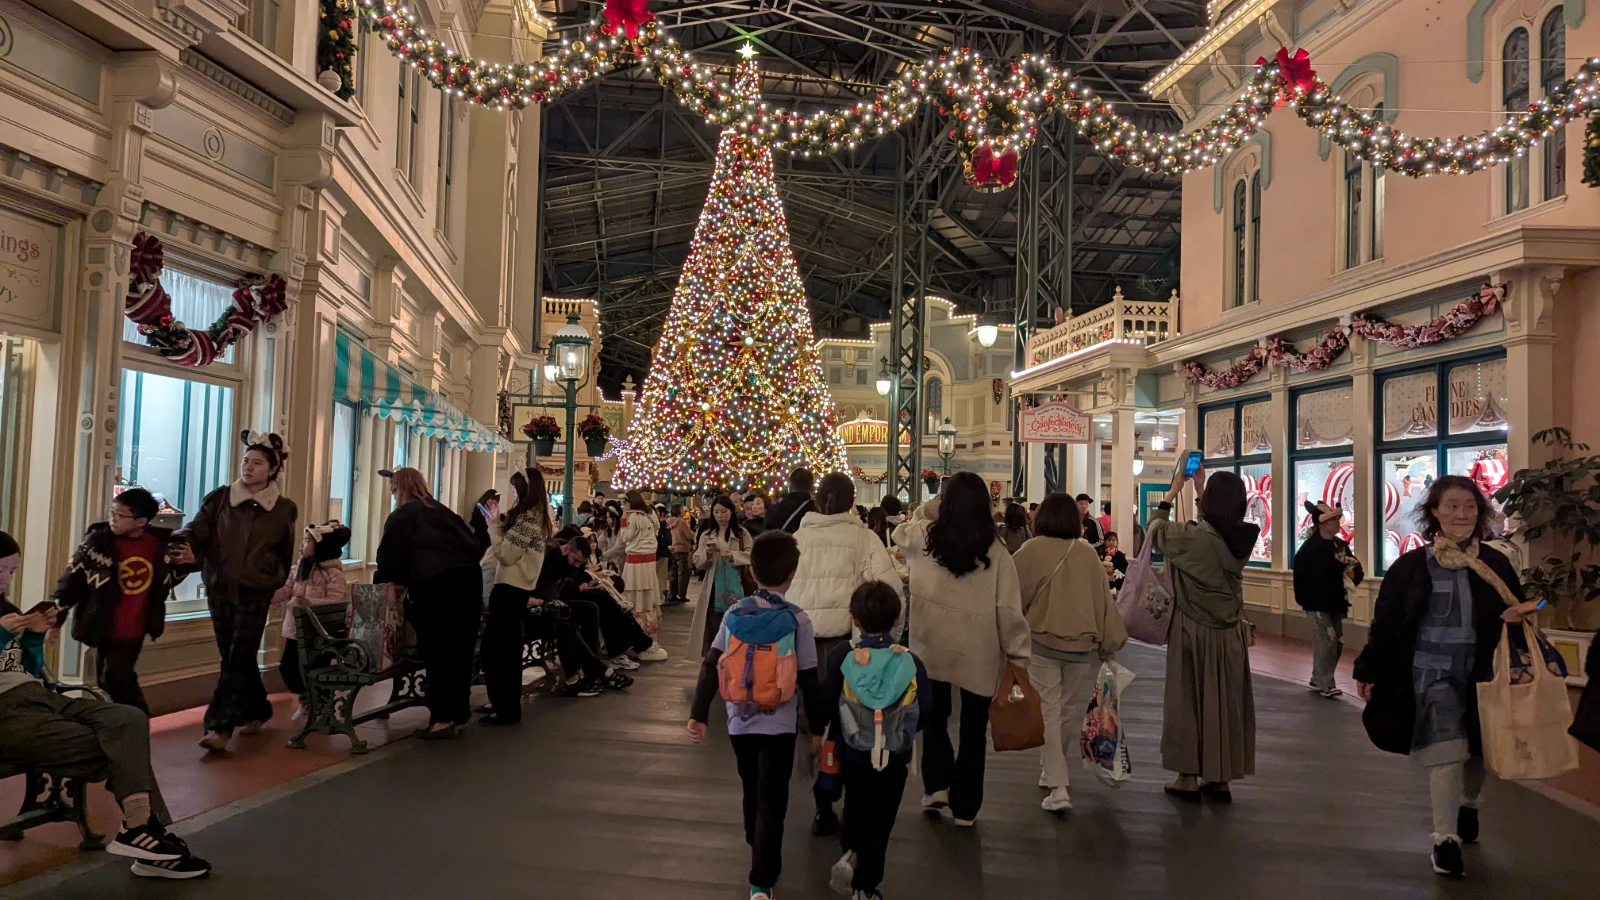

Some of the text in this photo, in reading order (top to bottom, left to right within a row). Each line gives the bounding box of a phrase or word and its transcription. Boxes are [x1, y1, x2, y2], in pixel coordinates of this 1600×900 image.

[1412, 400, 1480, 422] CANDIES
[1031, 414, 1082, 434] Confectionery
[856, 425, 907, 444] EMPORM
